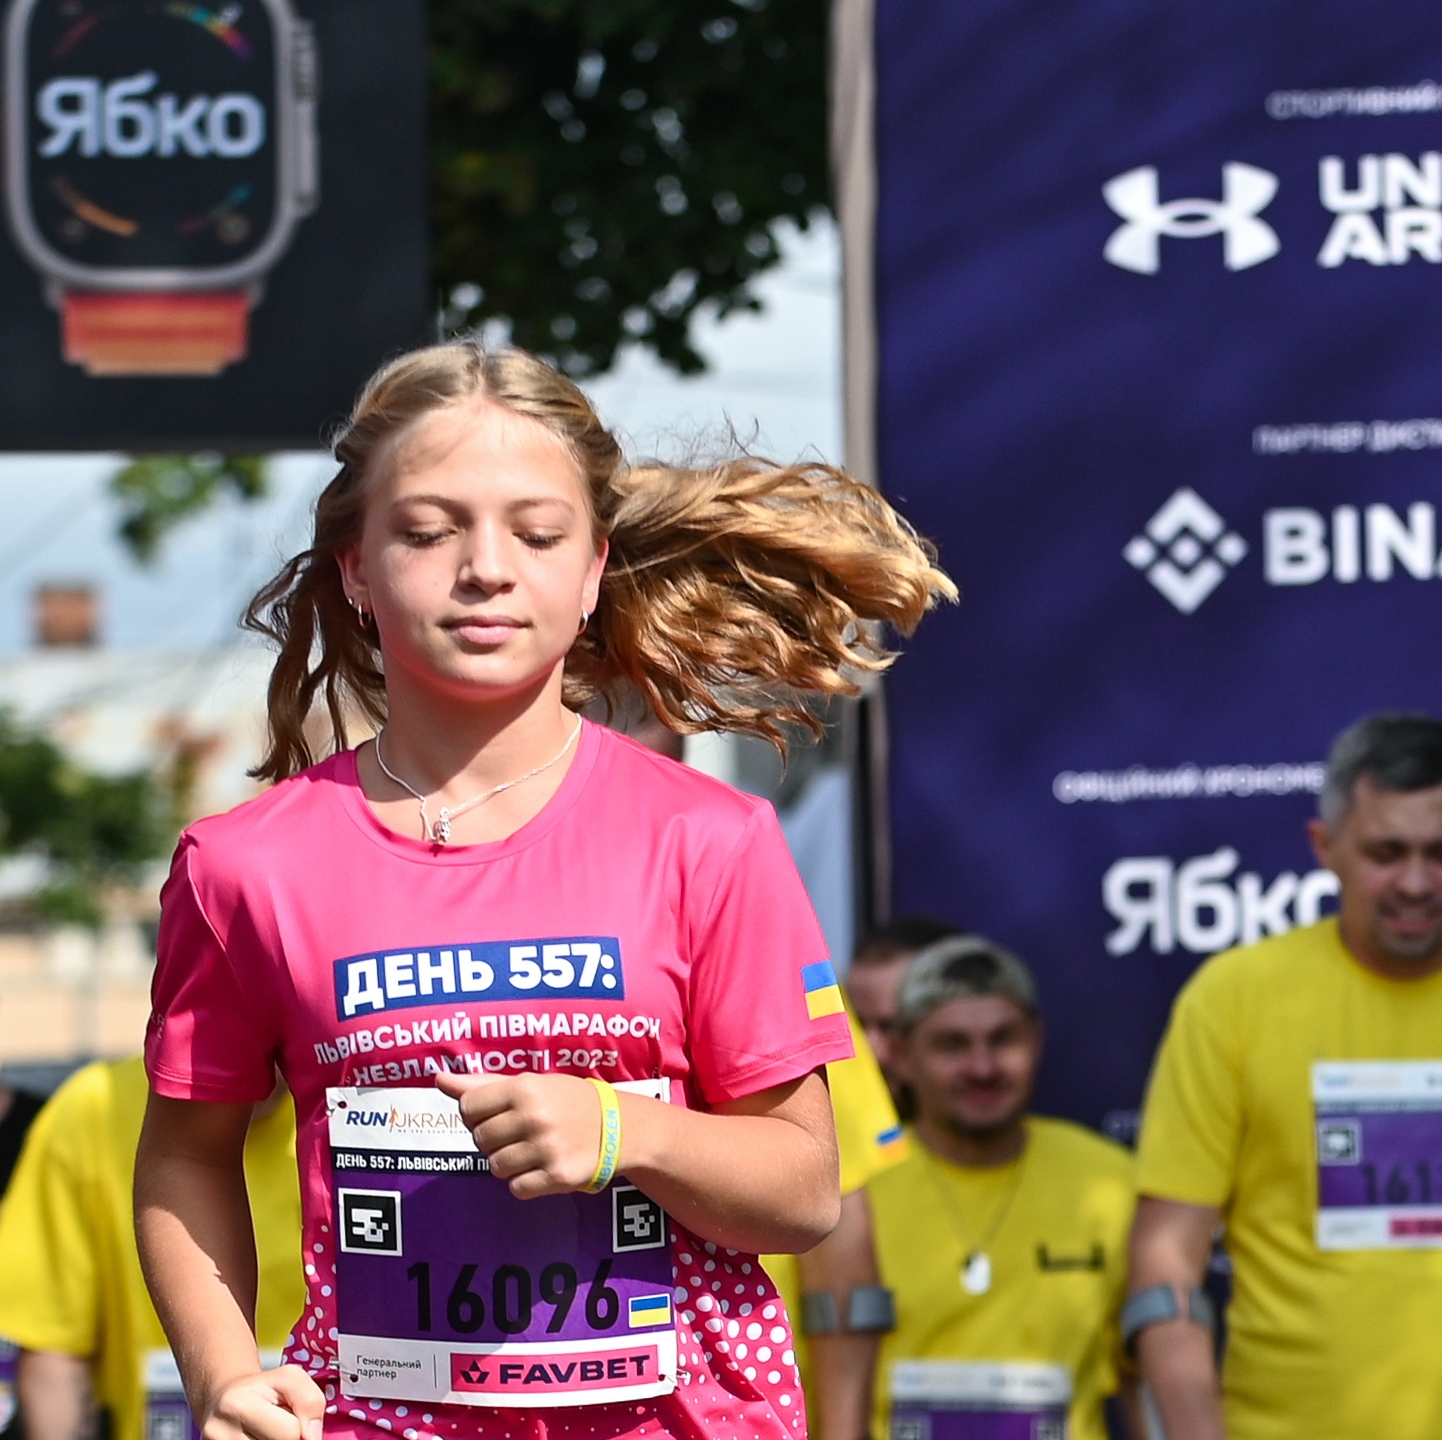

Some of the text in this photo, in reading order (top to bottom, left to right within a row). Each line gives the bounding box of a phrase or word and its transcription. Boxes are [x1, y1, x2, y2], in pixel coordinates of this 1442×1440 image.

[35, 71, 267, 158] Ябко
[343, 943, 617, 1016] ДЕНЬ 557:
[314, 1012, 661, 1065] ЛЬВІВСЬКИЙ ПІВМАРАФОН
[353, 1049, 619, 1086] НЕЗЛАМНОСТІ 2023
[346, 1110, 464, 1128] RUN UKRAIN
[336, 1153, 367, 1169] ДЕНЬ
[370, 1156, 395, 1169] 557:
[397, 1155, 474, 1171] ЛЬВІВСЬКИЙ
[407, 1258, 620, 1334] 16096
[356, 1355, 423, 1369] Генеральний
[357, 1368, 397, 1380] партнер
[499, 1354, 651, 1385] FAVBET
